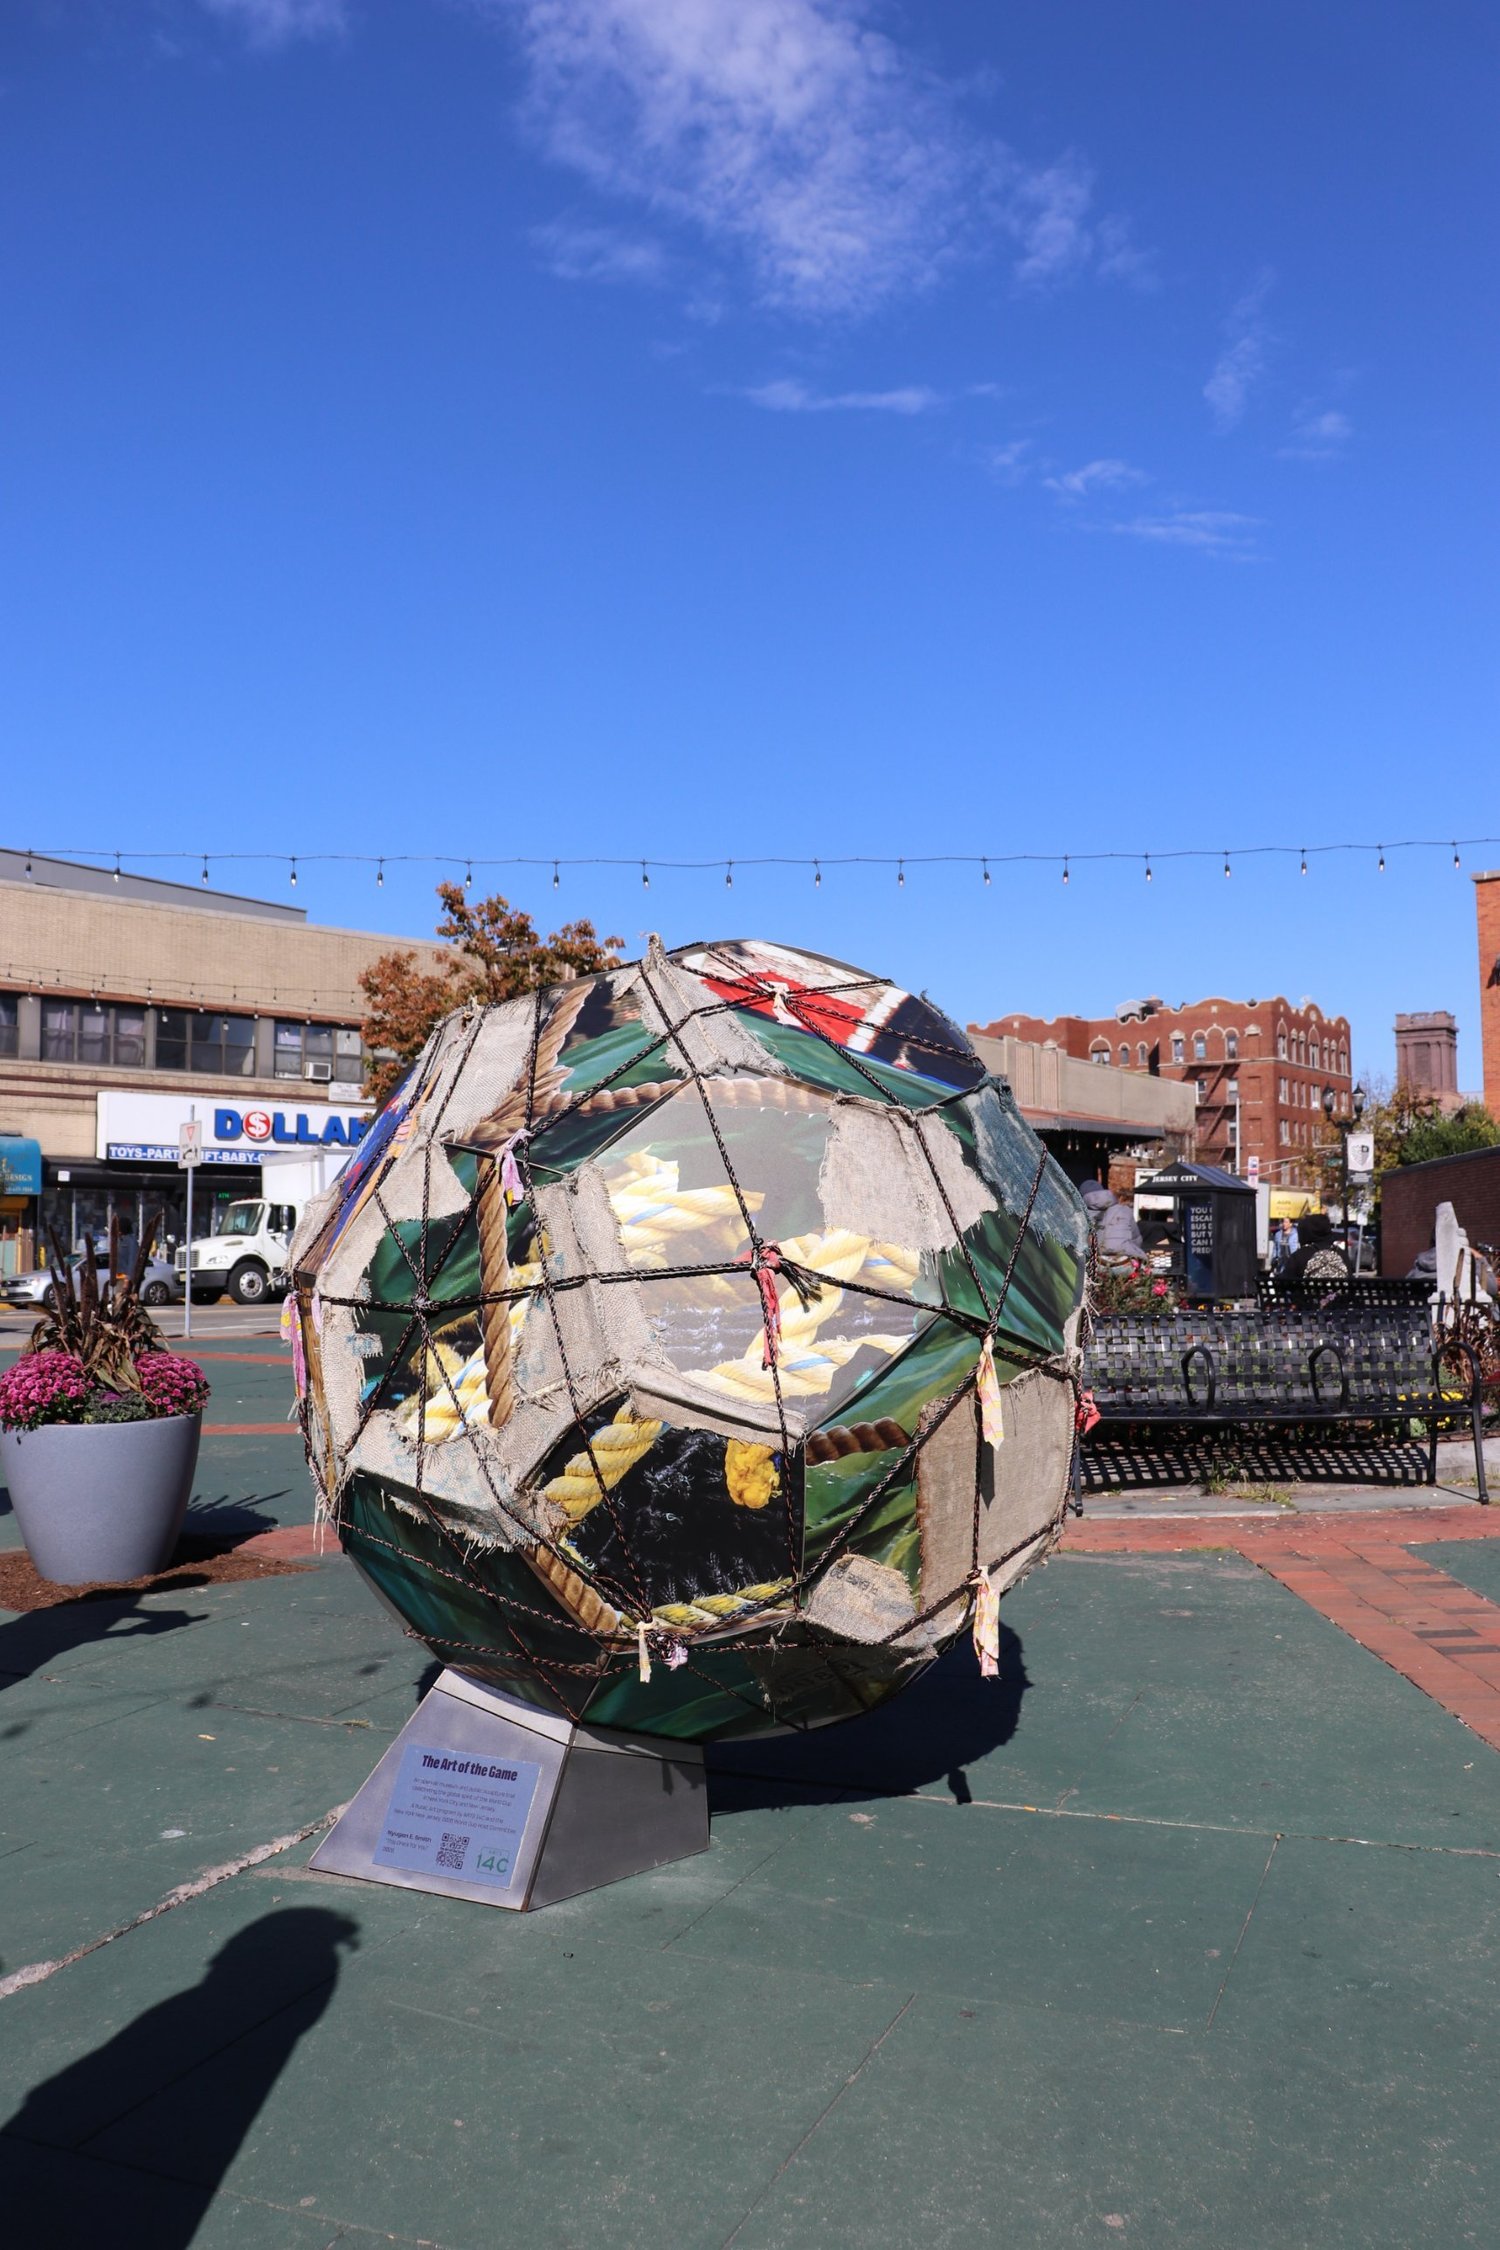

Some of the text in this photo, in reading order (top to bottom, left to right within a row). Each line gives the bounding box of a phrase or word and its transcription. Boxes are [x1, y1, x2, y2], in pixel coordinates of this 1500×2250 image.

[1152, 1174, 1198, 1183] JERSEY CITY
[422, 1755, 518, 1781] The Art of the Game
[414, 1834, 432, 1843] Smith
[476, 1854, 509, 1873] 14C
